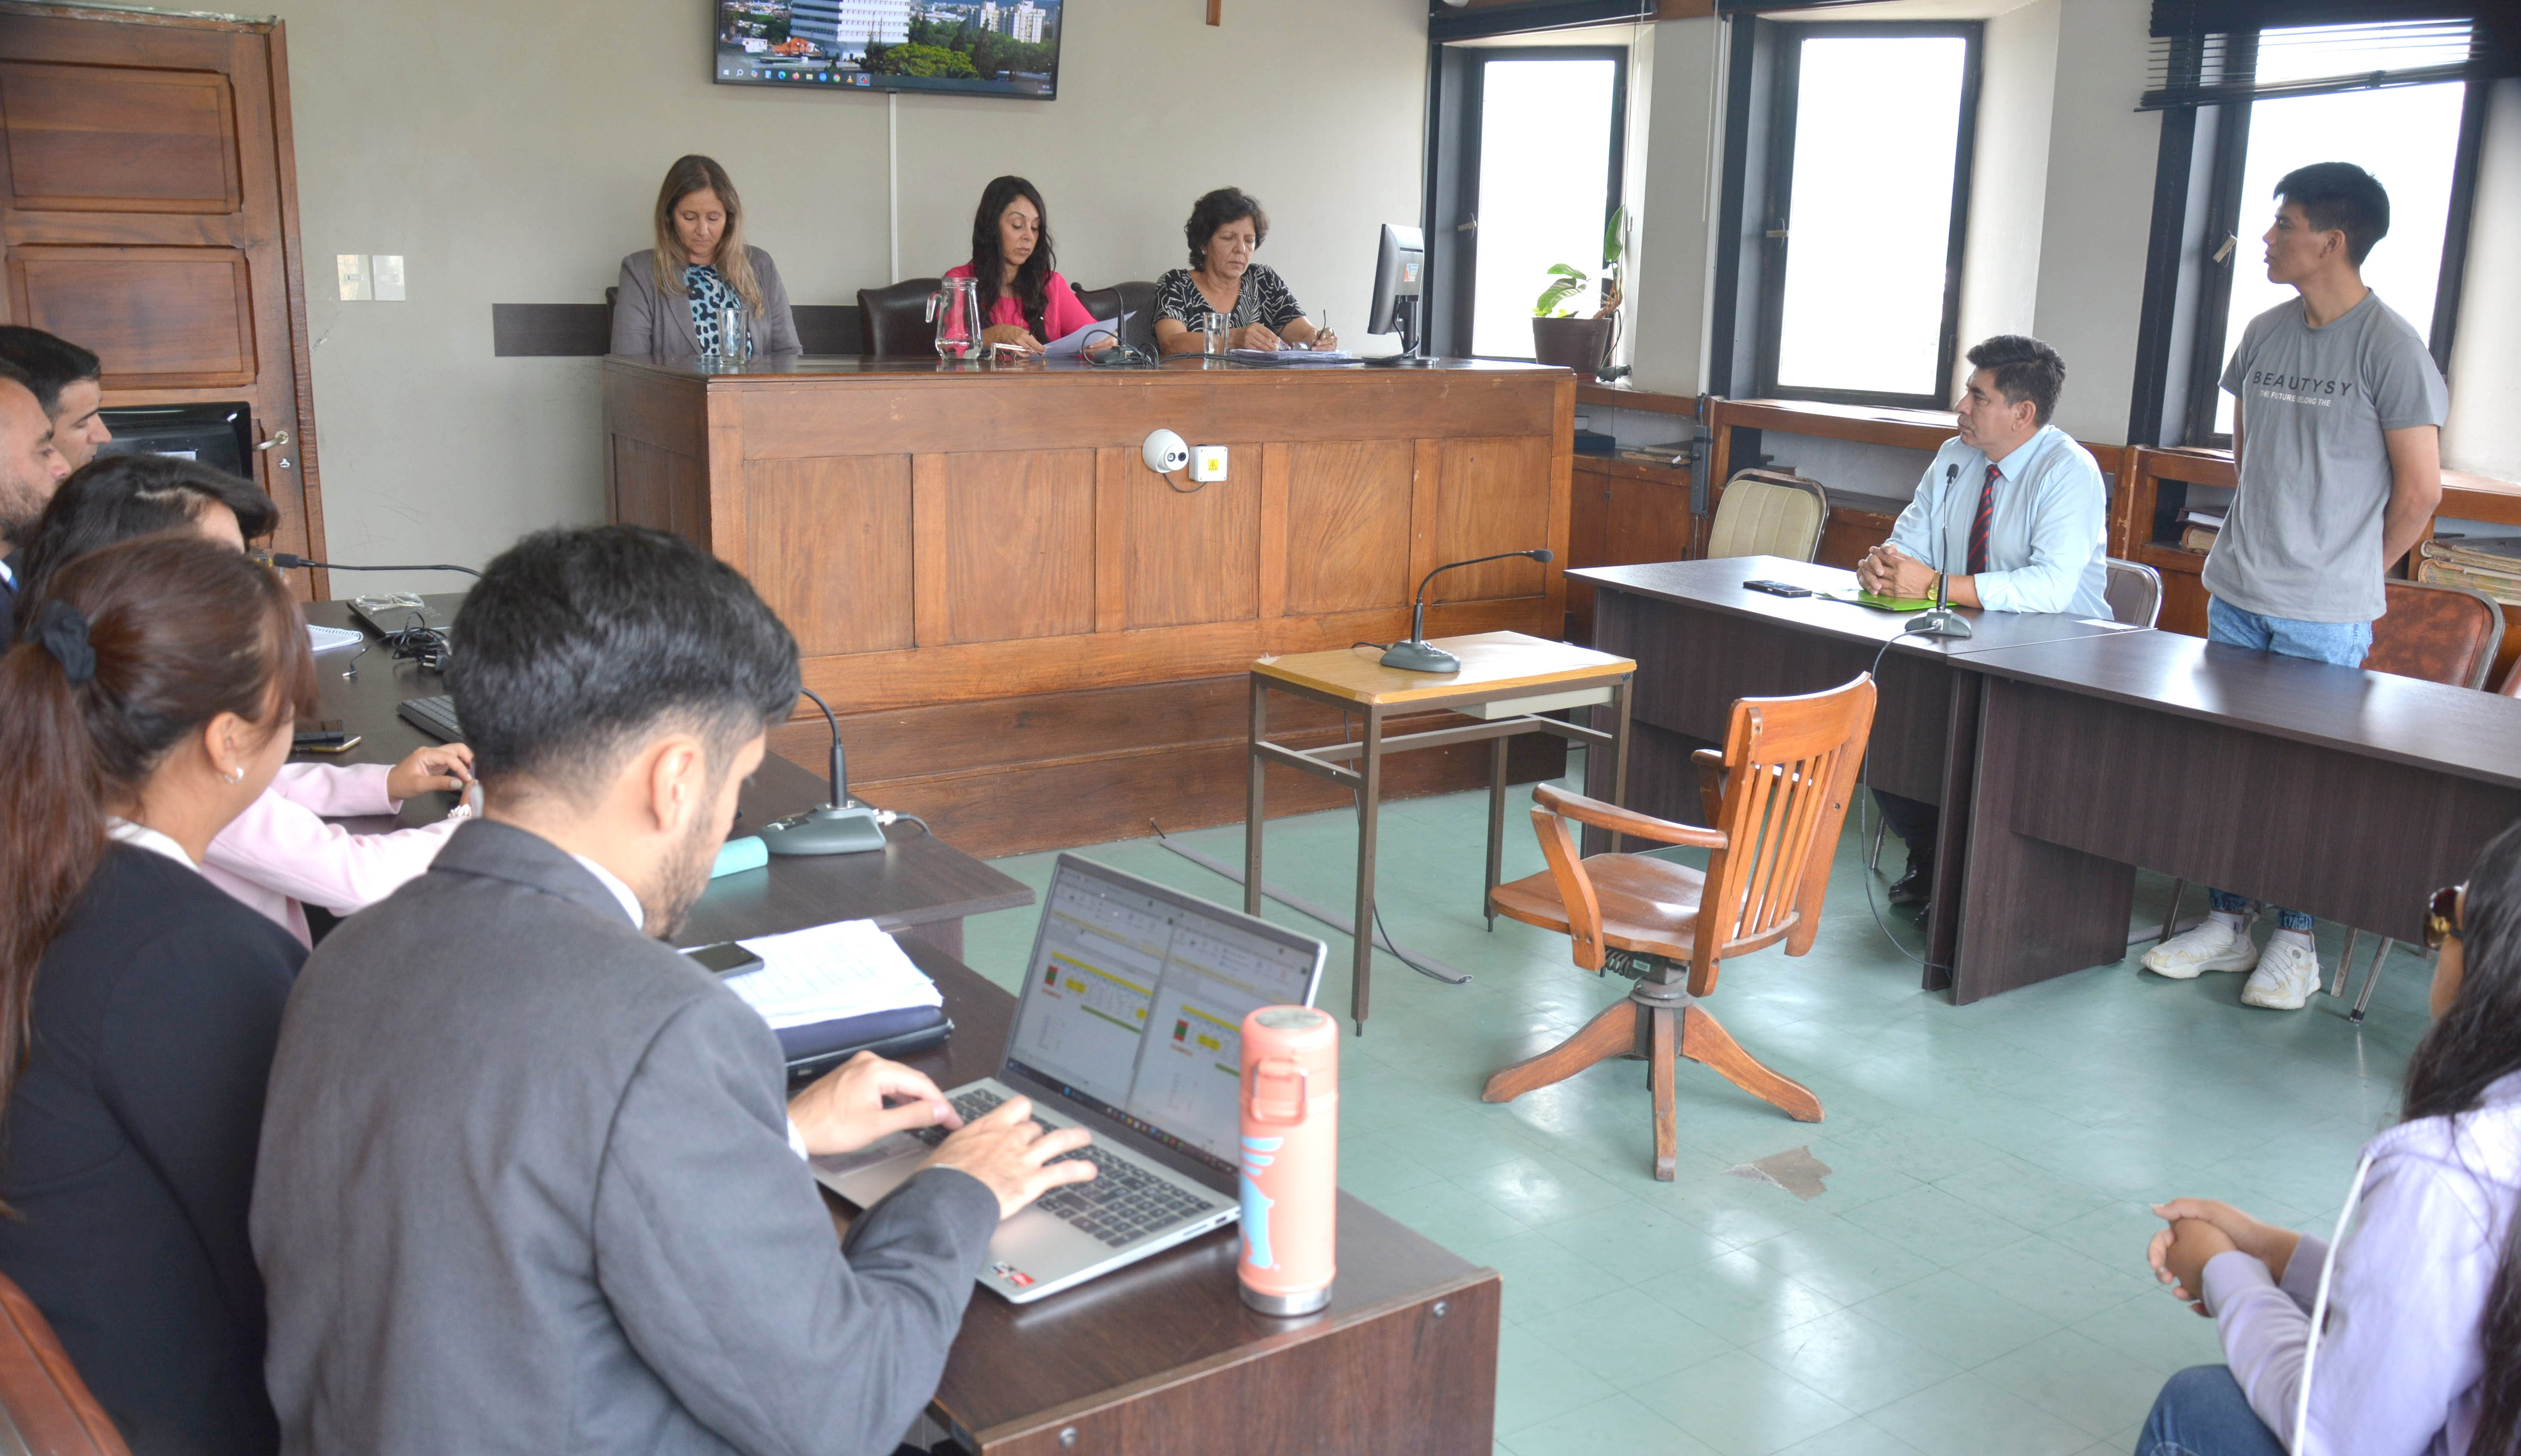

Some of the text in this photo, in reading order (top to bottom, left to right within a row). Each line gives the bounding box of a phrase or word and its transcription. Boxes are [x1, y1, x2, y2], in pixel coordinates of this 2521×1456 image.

[2253, 371, 2352, 396] BEAUTYSY
[2260, 390, 2269, 398] THE
[2271, 392, 2296, 402] FUTURE
[2318, 398, 2331, 406] THE
